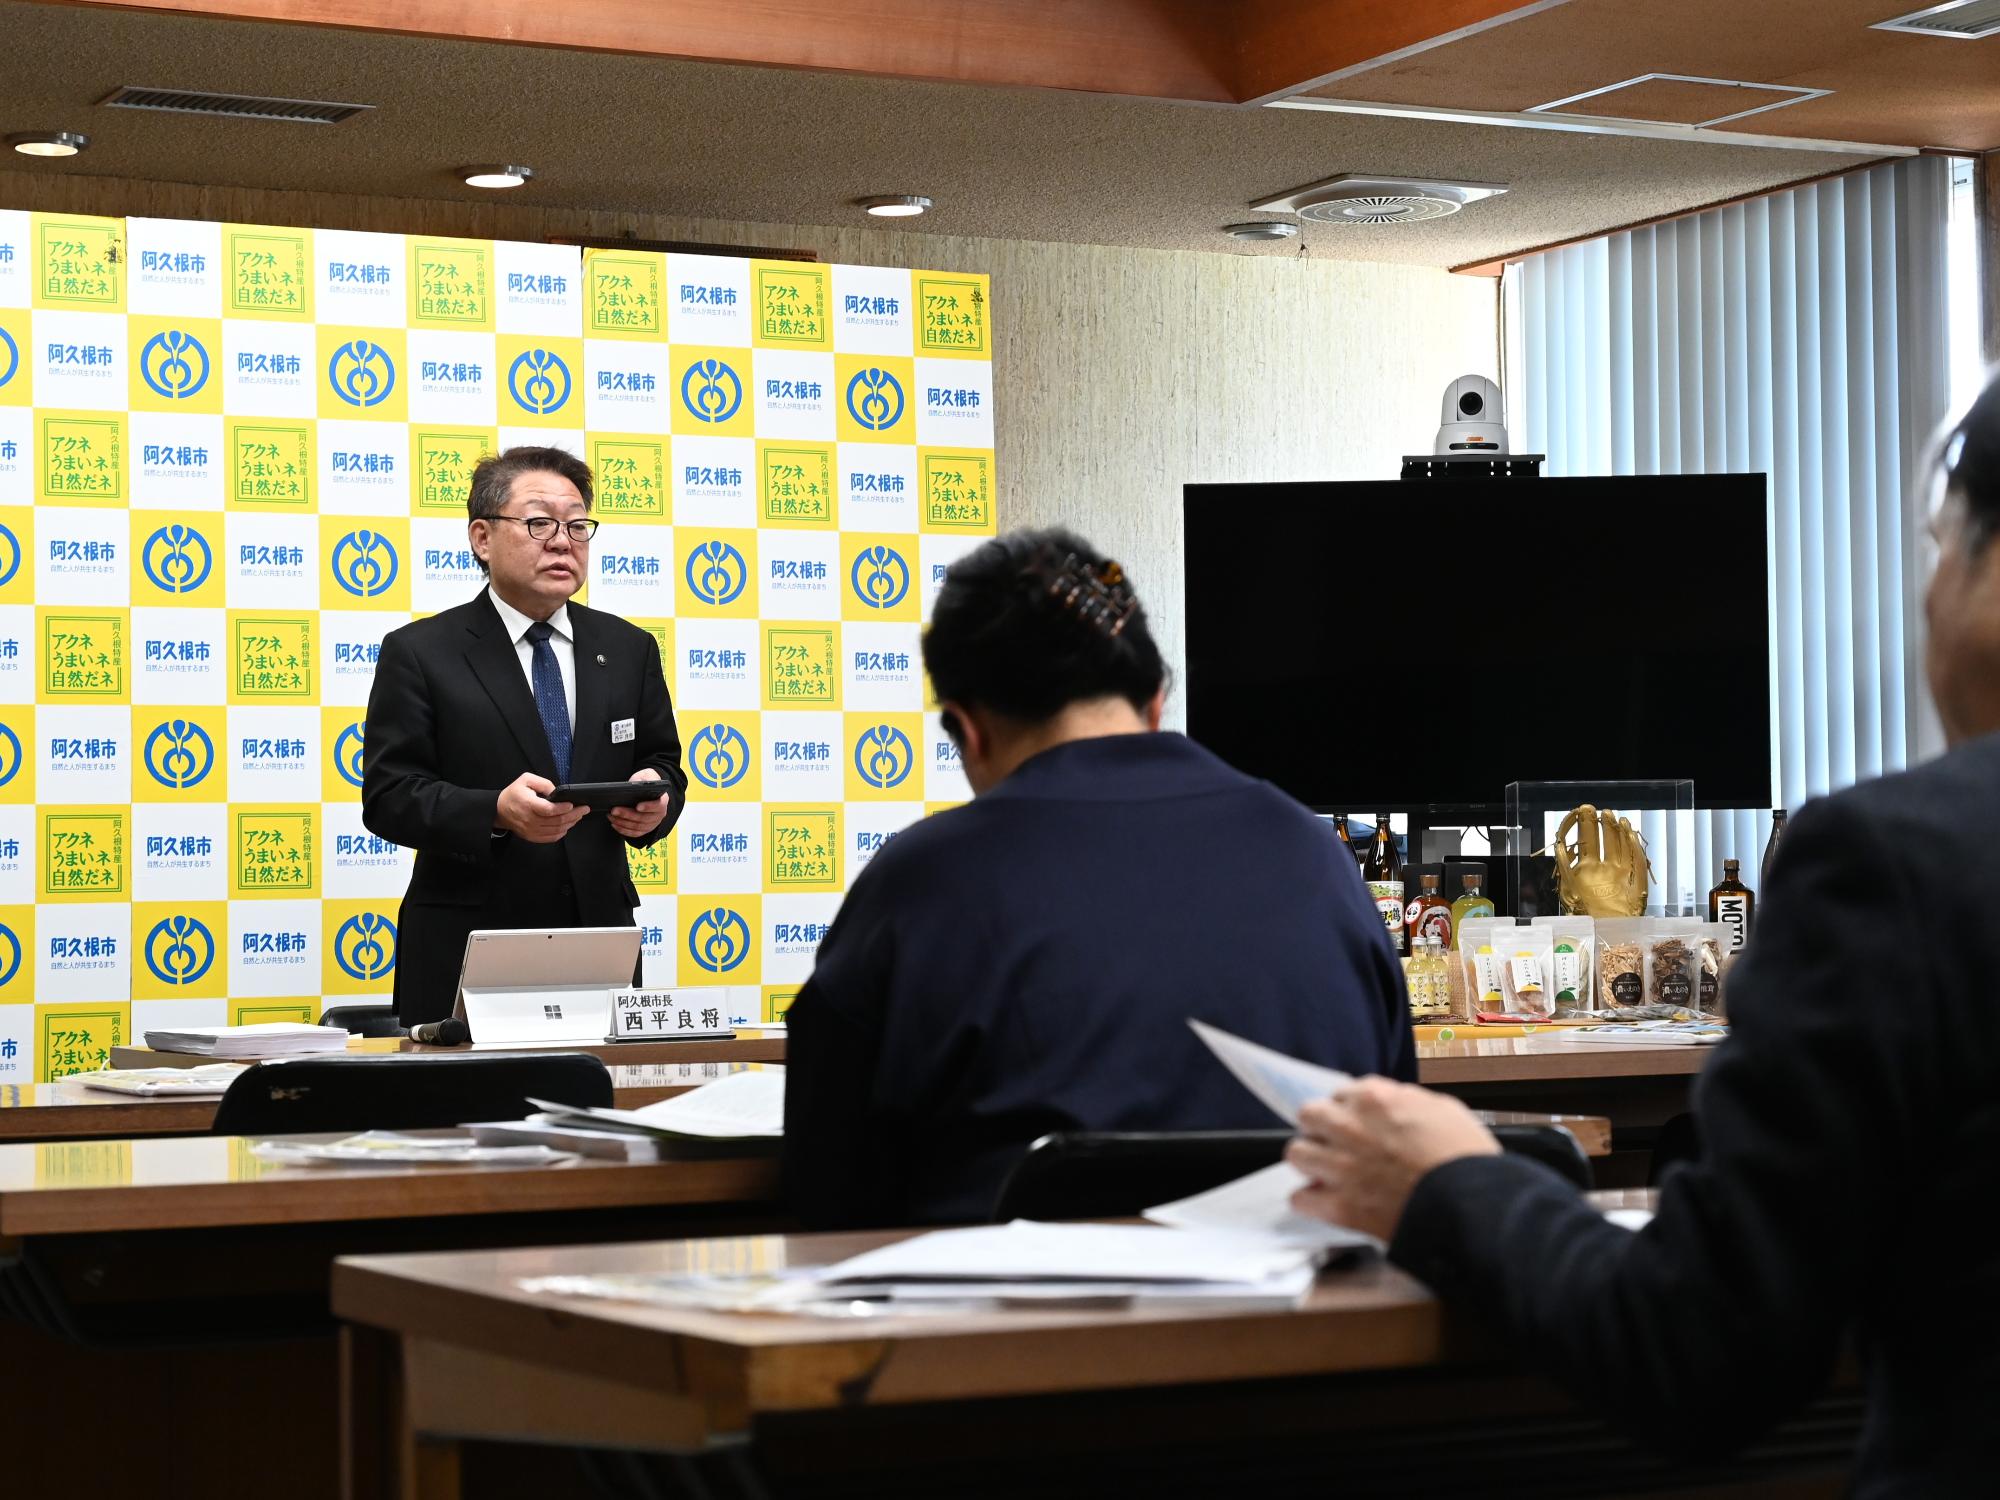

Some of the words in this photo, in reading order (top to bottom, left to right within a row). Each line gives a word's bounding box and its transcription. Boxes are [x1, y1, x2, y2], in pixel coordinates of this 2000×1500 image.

[48, 240, 89, 258] アクネ
[49, 258, 106, 278] うまいネ
[141, 250, 205, 273] 阿久根市
[238, 251, 278, 268] アクネ
[239, 269, 294, 288] うまいネ
[329, 262, 389, 284] 阿久根市
[421, 262, 460, 279] アクネ
[48, 276, 108, 298] 自然だネ
[422, 280, 476, 298] うまいネ
[508, 272, 565, 293] 阿久根市
[597, 274, 634, 290] アクネ
[238, 286, 296, 307] 自然だネ
[598, 291, 649, 309] うまいネ
[680, 284, 737, 305] 阿久根市
[765, 284, 800, 300] アクネ
[422, 297, 478, 317] 自然だネ
[766, 301, 815, 319] うまいネ
[844, 295, 899, 315] 阿久根市
[925, 295, 959, 310] アクネ
[597, 308, 652, 328] 自然だネ
[765, 317, 817, 337] 自然だネ
[926, 311, 974, 328] うまいネ
[926, 328, 976, 346] 自然だネ
[47, 343, 113, 366] 阿久根市
[238, 351, 301, 373] 阿久根市
[421, 361, 482, 382] 阿久根市
[597, 370, 655, 391] 阿久根市
[766, 379, 822, 400] 阿久根市
[927, 387, 980, 408] 阿久根市
[51, 436, 92, 453] アクネ
[240, 443, 281, 459] アクネ
[52, 454, 109, 473] うまいネ
[143, 445, 208, 466] 阿久根市
[332, 451, 394, 473] 阿久根市
[425, 450, 463, 466] アクネ
[241, 461, 297, 479] うまいネ
[601, 458, 638, 473] アクネ
[769, 464, 805, 479] アクネ
[51, 472, 111, 492] 自然だネ
[602, 475, 653, 492] うまいネ
[685, 466, 741, 486] 阿久根市
[851, 472, 905, 493] 阿久根市
[930, 470, 965, 485] アクネ
[241, 478, 299, 498] 自然だネ
[425, 485, 468, 501] 自然だ
[770, 481, 820, 498] うまいネ
[931, 487, 979, 503] うまいネ
[601, 492, 656, 511] 自然だネ
[770, 497, 823, 516] 自然だネ
[931, 503, 981, 521] 自然だネ
[50, 540, 115, 561] 阿久根市
[240, 544, 304, 566] 阿久根市
[601, 555, 660, 576] 阿久根市
[771, 559, 827, 580] 阿久根市
[52, 634, 94, 650] アクネ
[145, 639, 210, 661] 阿久根市
[243, 636, 283, 652] アクネ
[53, 652, 111, 669] うまいネ
[244, 654, 299, 671] うまいネ
[335, 643, 382, 663] 阿久根
[689, 649, 746, 669] 阿久根市
[774, 646, 809, 660] アクネ
[855, 651, 909, 671] 阿久根市
[52, 670, 113, 689] 自然だネ
[775, 663, 824, 678] うまいネ
[243, 672, 302, 691] 自然だネ
[774, 679, 826, 696] 自然だネ
[51, 738, 117, 760] 阿久根市
[242, 738, 305, 759] 阿久根市
[774, 741, 829, 760] 阿久根市
[936, 742, 963, 761] 阿久
[53, 832, 94, 848] アクネ
[244, 830, 284, 845] アクネ
[690, 832, 748, 852] 阿久根市
[776, 828, 812, 842] アクネ
[857, 831, 898, 851] 阿久
[146, 836, 212, 857] 阿久根市
[245, 848, 301, 864] うまいネ
[777, 845, 826, 860] うまいネ
[53, 851, 111, 867] うまいネ
[52, 869, 113, 888] 自然だネ
[244, 866, 303, 884] 自然だネ
[628, 863, 660, 878] だネ
[777, 861, 828, 879] 自然だネ
[50, 936, 116, 958] 阿久根市
[242, 931, 306, 953] 阿久根市
[617, 994, 673, 1009] 阿久根市長
[624, 1008, 720, 1031] 西平良将
[51, 1031, 93, 1047] アクネ
[52, 1049, 110, 1067] うまいネ
